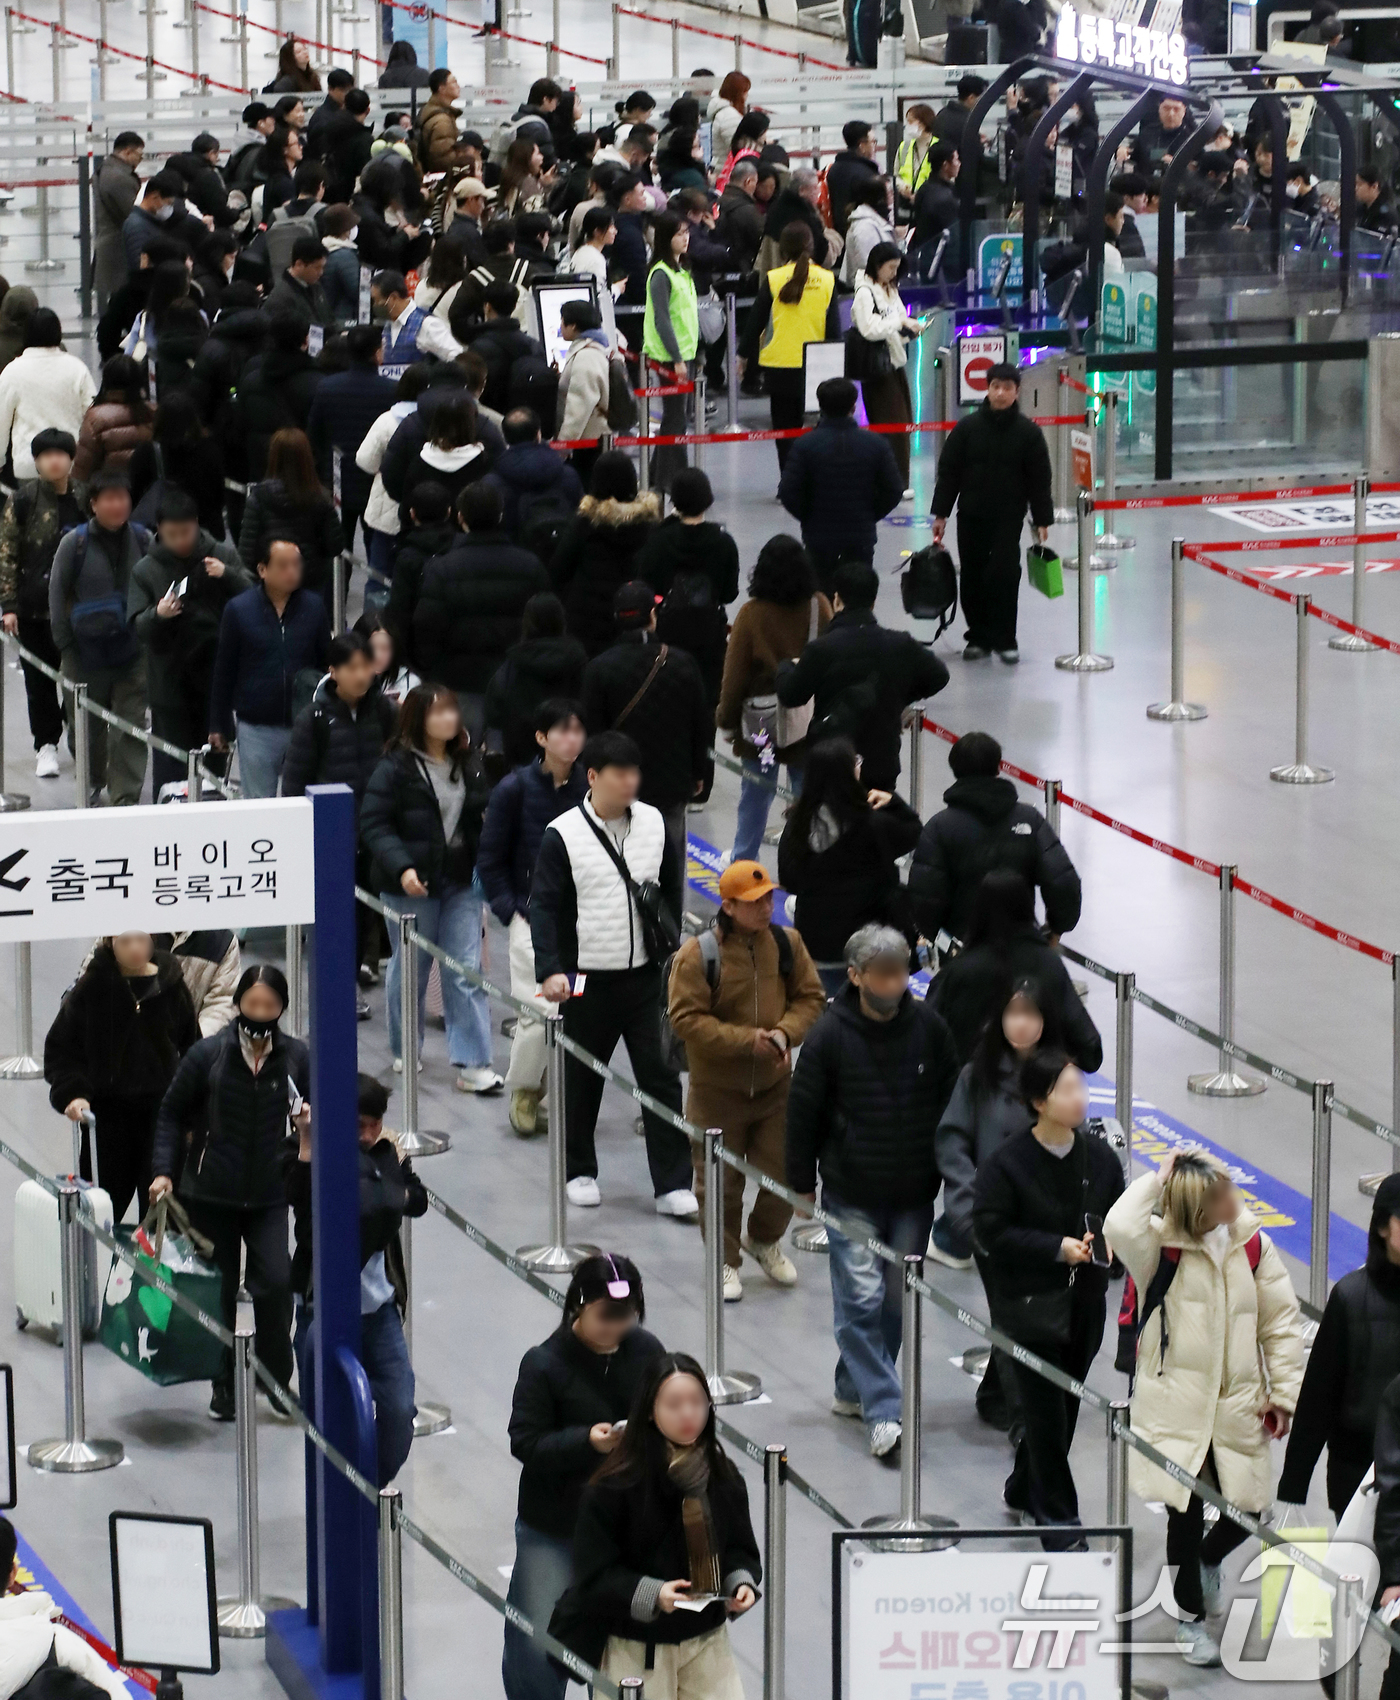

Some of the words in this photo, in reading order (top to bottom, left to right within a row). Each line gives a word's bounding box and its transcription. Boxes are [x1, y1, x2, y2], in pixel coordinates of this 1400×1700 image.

[983, 342, 1003, 353] 불가
[46, 858, 134, 902] 출국
[152, 871, 278, 906] 등록고객
